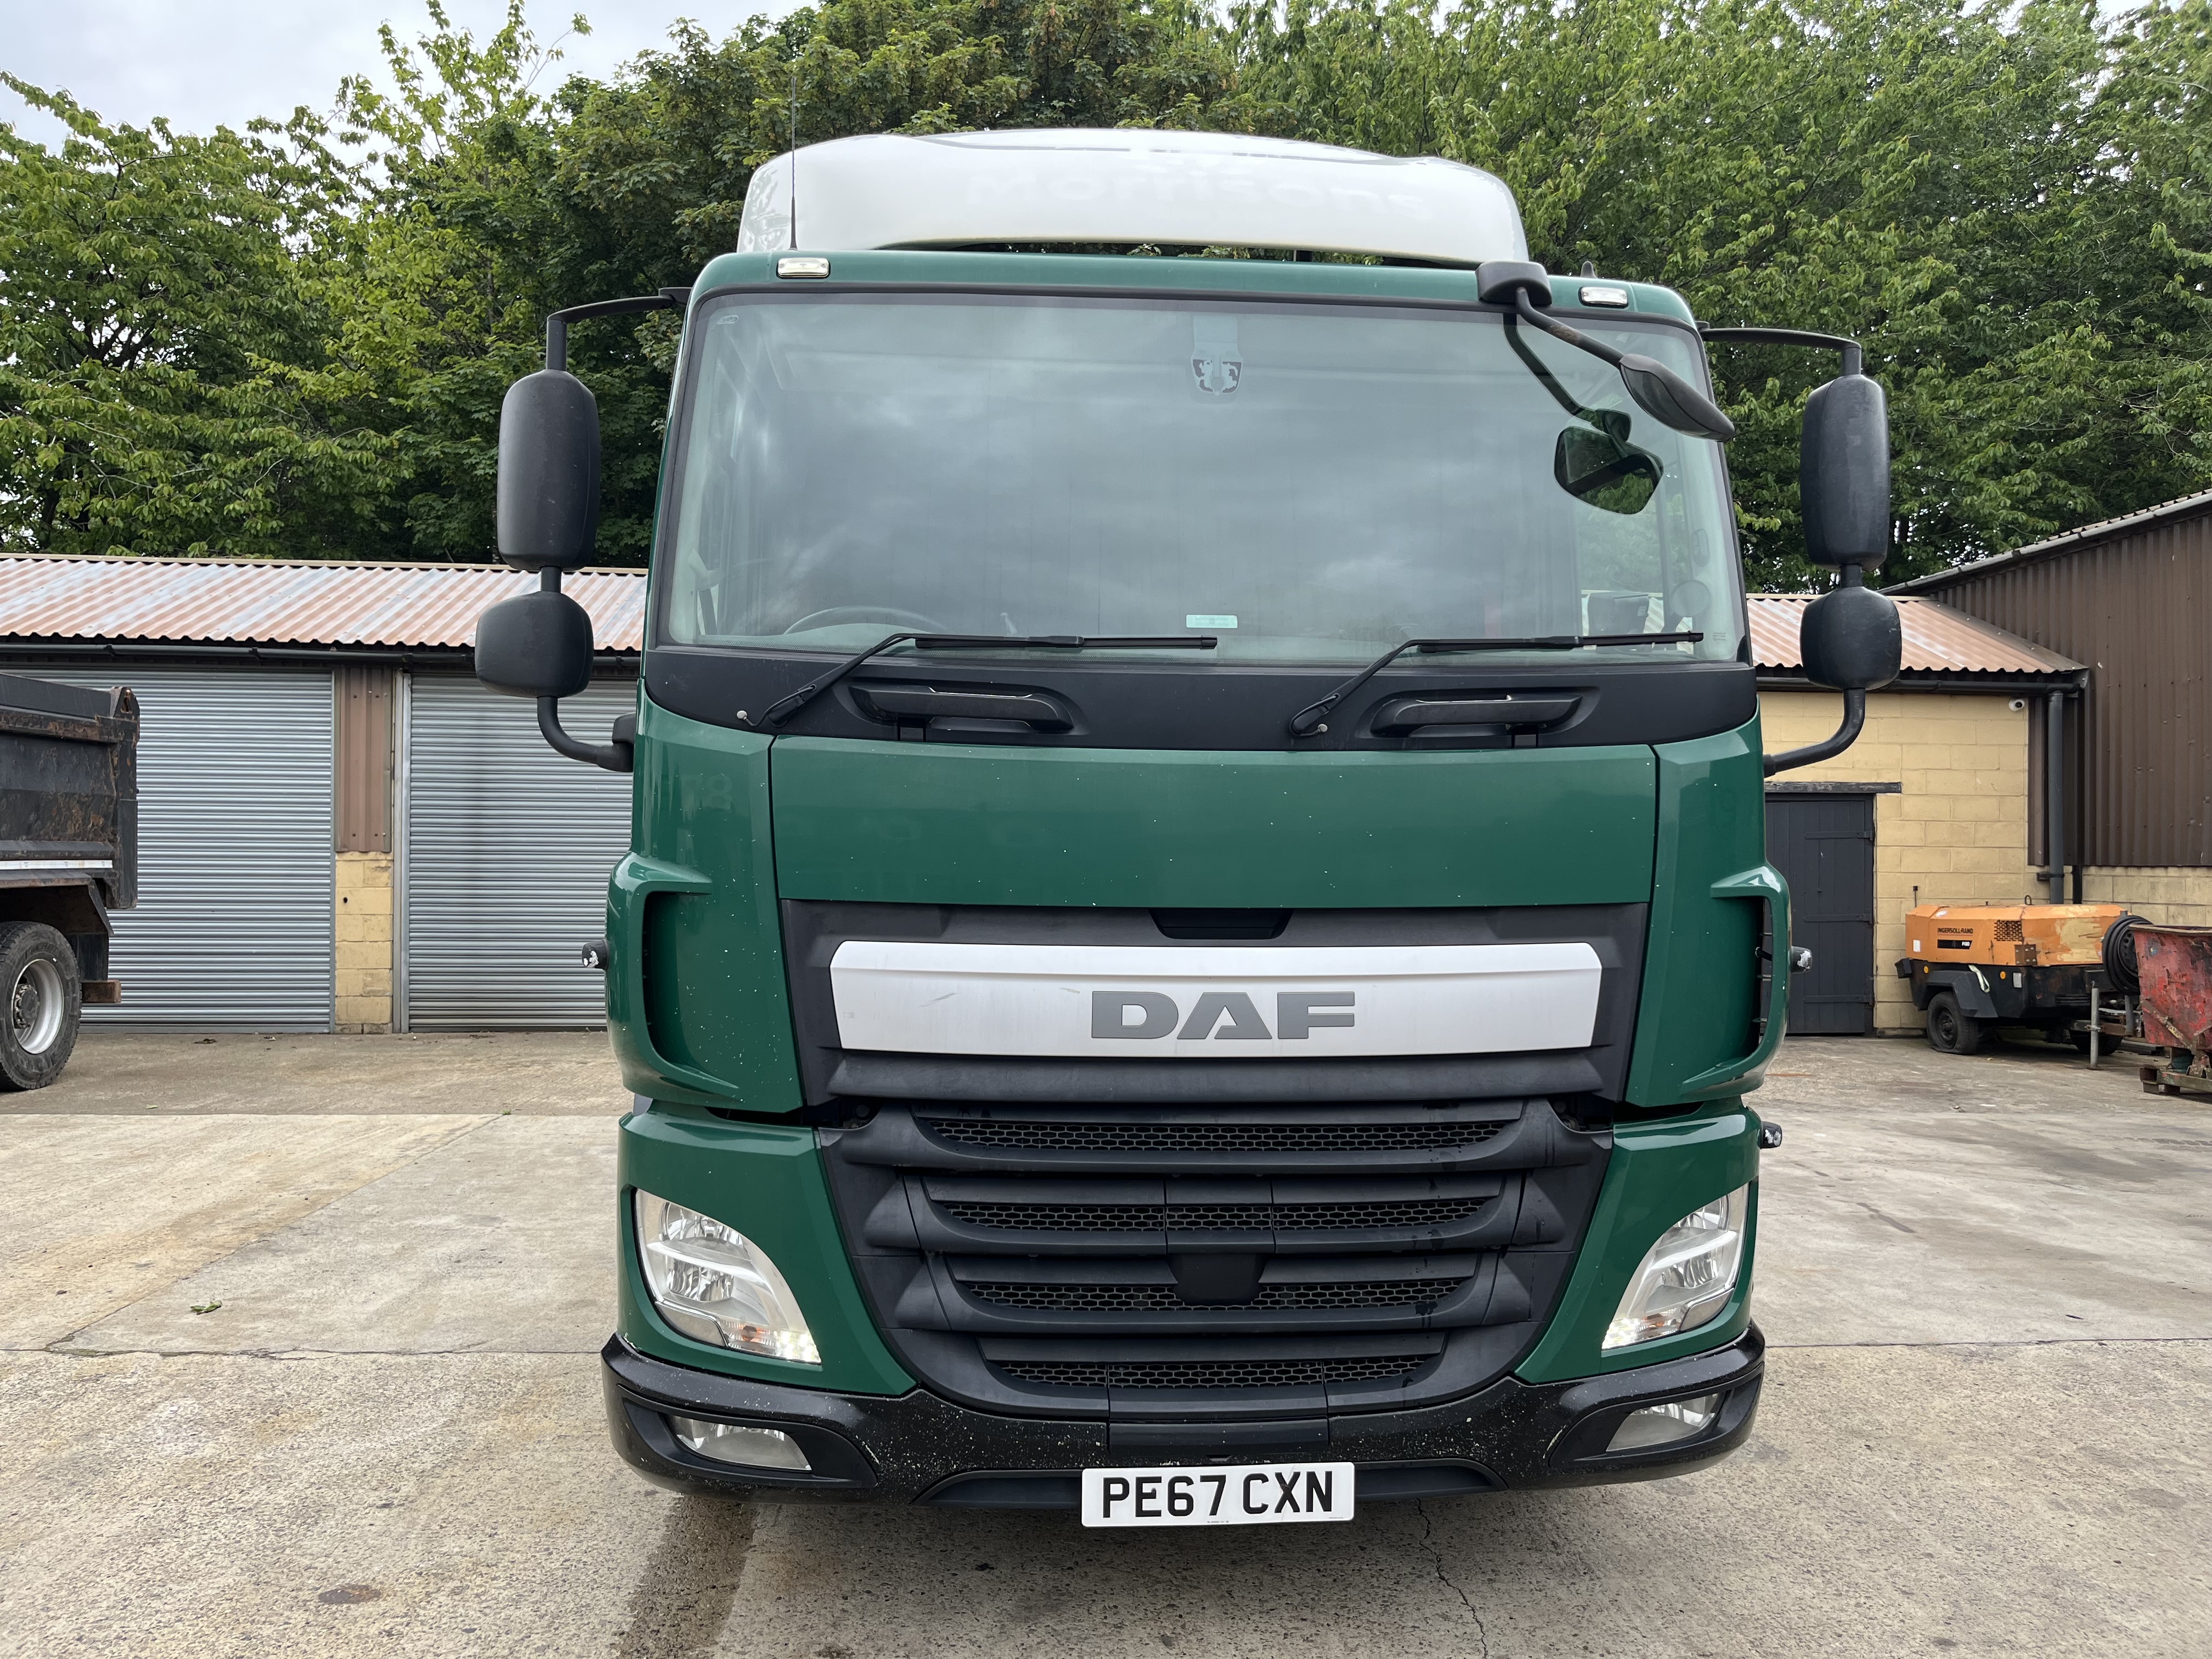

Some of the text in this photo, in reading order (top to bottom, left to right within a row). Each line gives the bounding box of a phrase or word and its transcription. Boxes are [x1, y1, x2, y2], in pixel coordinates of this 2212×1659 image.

[1092, 991, 1355, 1040] DAF
[1102, 1471, 1333, 1518] PE67 CXN
